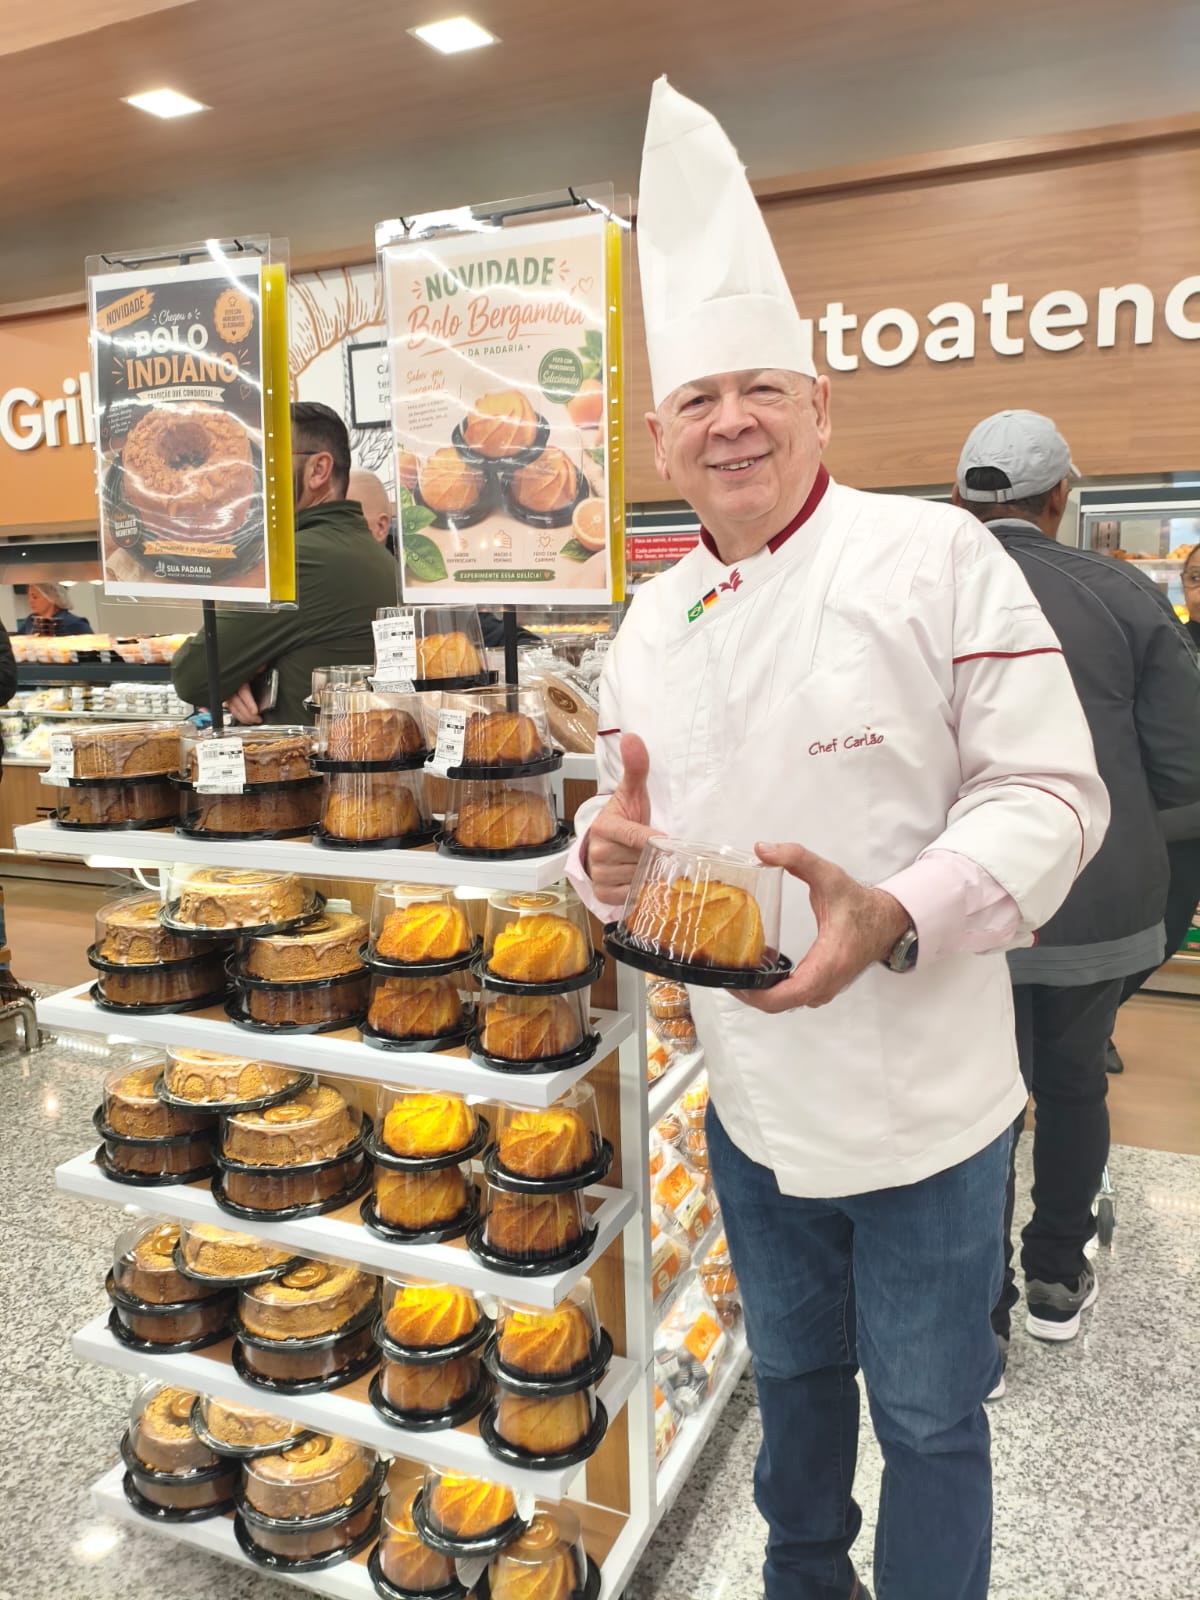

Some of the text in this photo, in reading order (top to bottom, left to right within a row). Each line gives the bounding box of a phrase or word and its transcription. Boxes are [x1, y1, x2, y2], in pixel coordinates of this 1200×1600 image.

[424, 257, 556, 302] NOVIDADE
[106, 295, 146, 326] NOVIDADE
[134, 323, 208, 357] BOLO
[407, 304, 463, 350] Bolo
[468, 345, 524, 357] DA PADARIA
[126, 352, 239, 391] INDIANO
[166, 564, 180, 573] SUA
[181, 565, 212, 575] PADARIA
[808, 738, 838, 756] Chef
